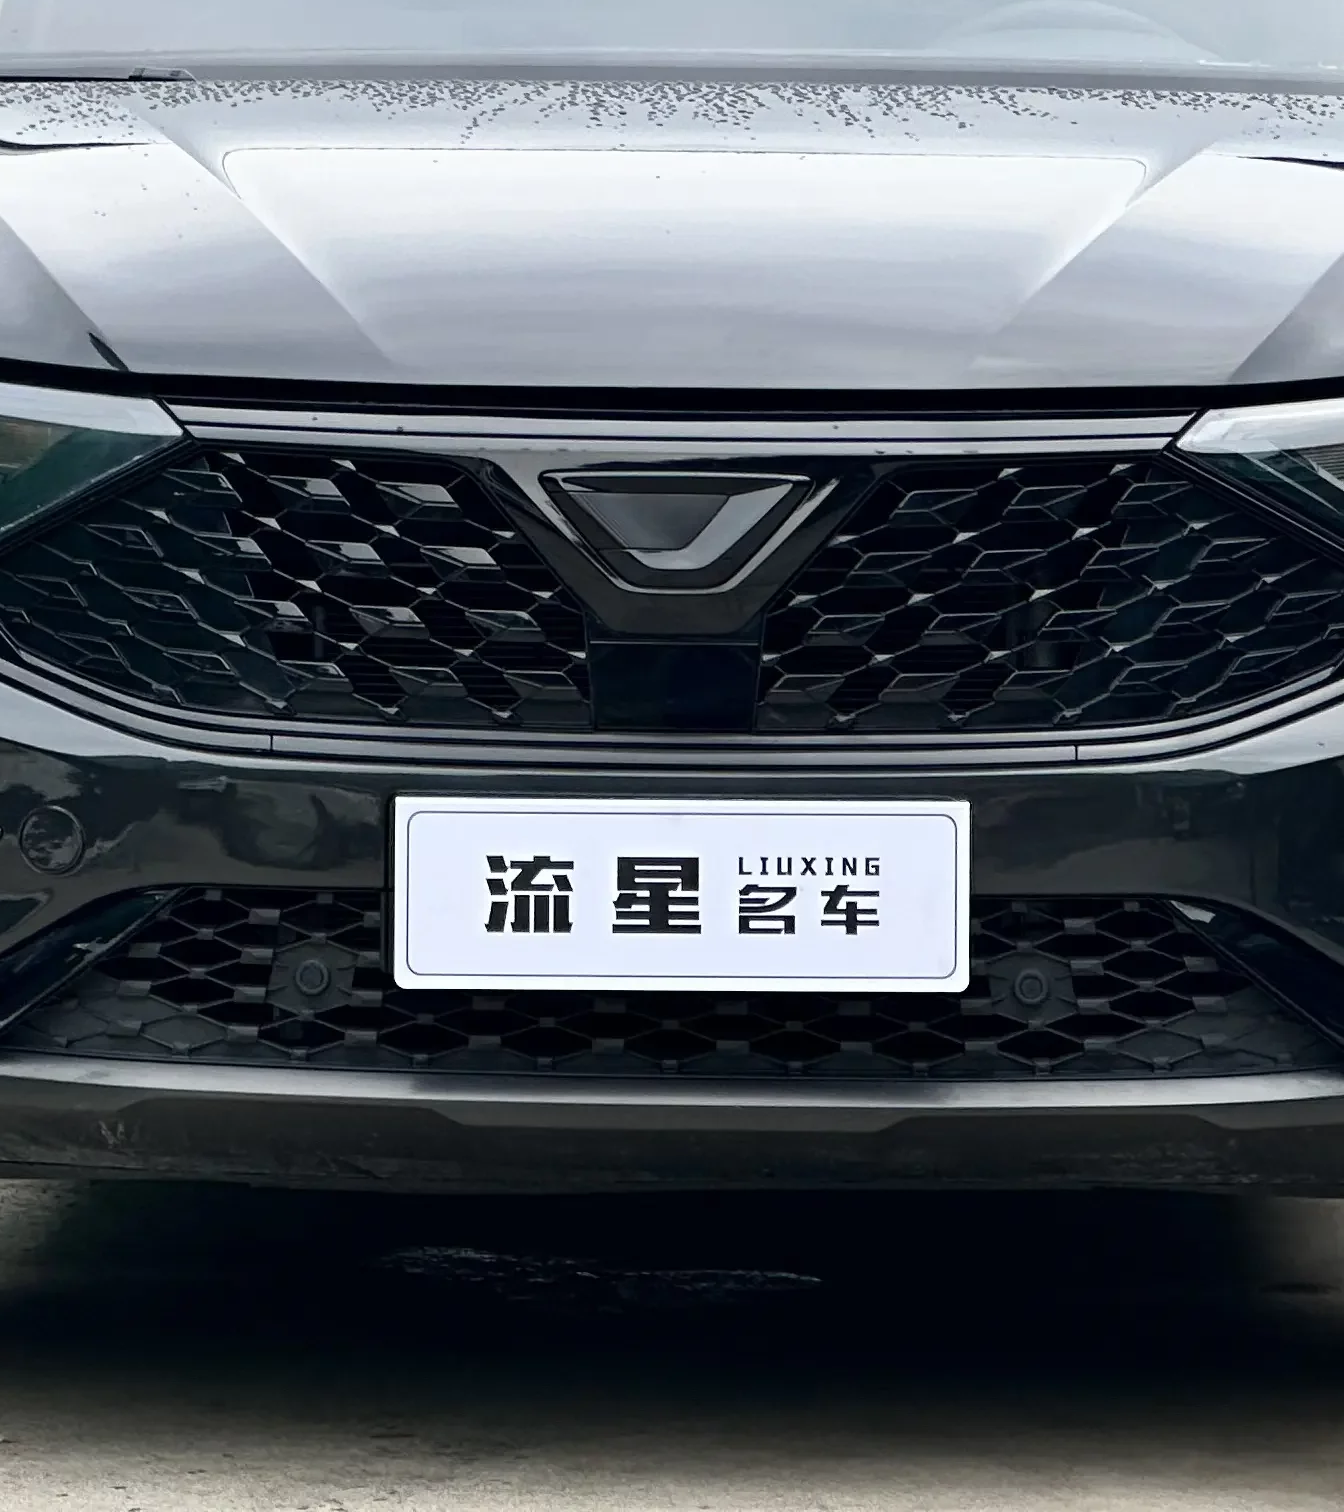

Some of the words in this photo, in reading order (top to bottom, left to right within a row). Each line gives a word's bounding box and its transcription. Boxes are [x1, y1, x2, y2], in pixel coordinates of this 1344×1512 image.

[738, 856, 881, 877] LIUXING
[485, 855, 702, 935] 流星
[738, 884, 881, 936] 名车
